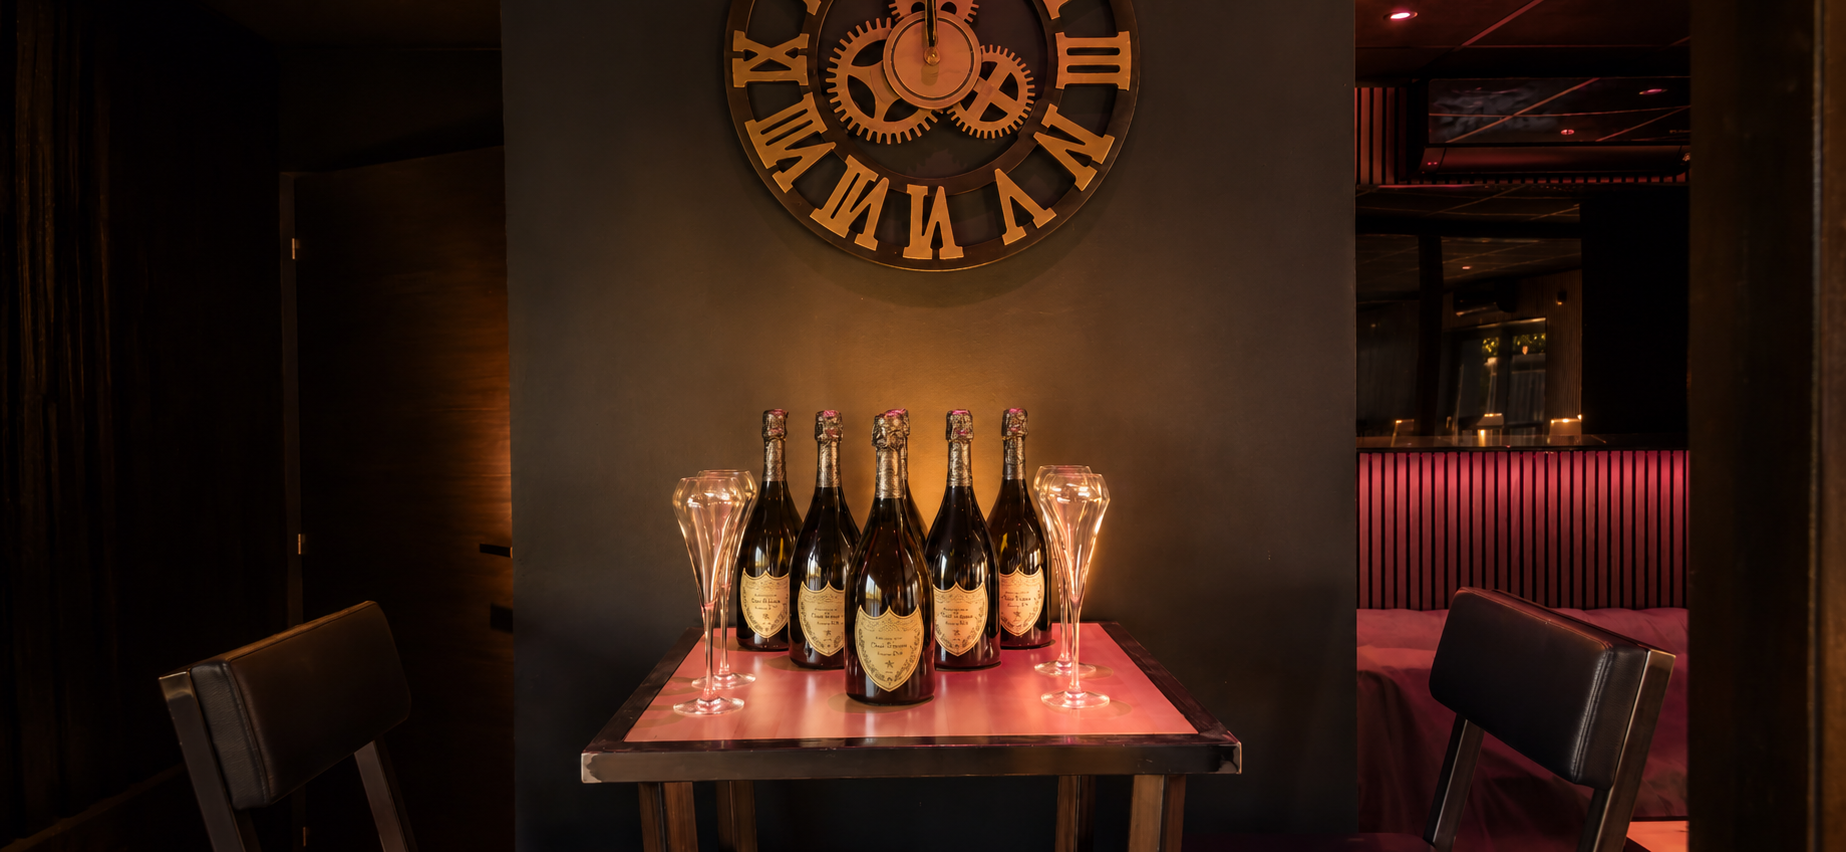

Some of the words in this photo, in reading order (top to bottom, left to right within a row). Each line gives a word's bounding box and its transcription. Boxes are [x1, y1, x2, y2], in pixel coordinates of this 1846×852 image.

[1056, 32, 1130, 90] III
[904, 185, 964, 259] VI
[996, 169, 1056, 245] V
